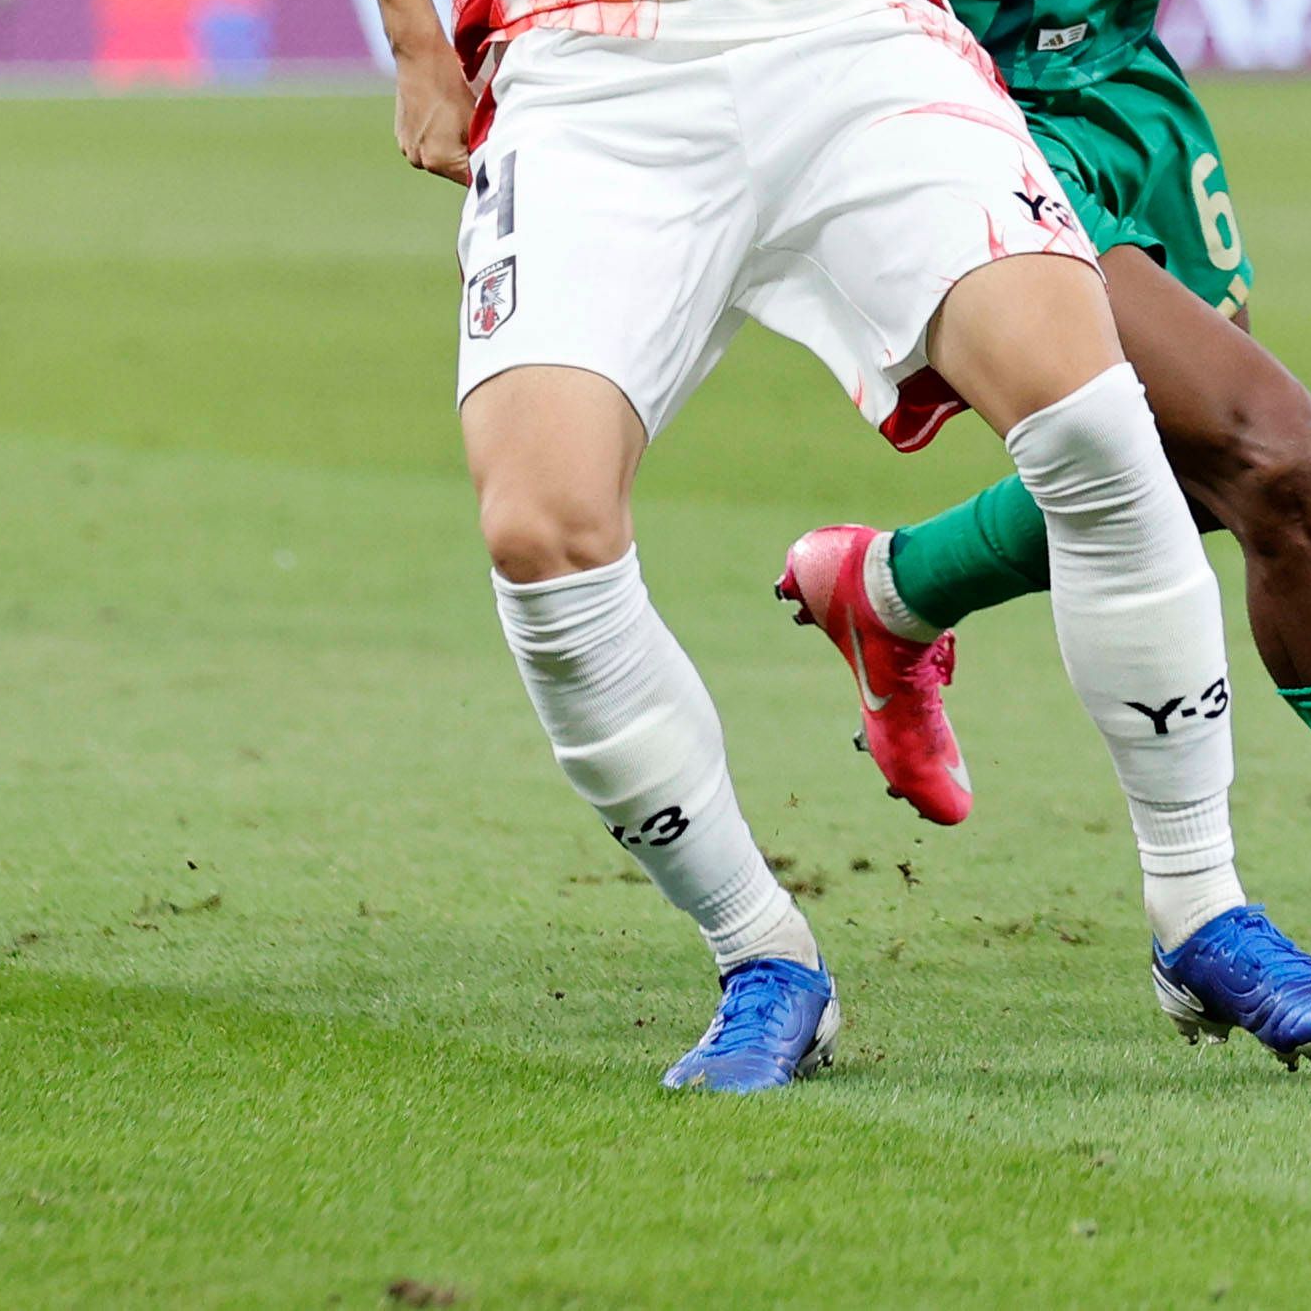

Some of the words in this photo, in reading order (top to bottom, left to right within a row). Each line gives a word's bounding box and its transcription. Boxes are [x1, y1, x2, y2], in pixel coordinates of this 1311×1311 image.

[474, 149, 517, 241] 4
[1012, 191, 1078, 232] Y-3
[1191, 152, 1242, 271] 6
[1122, 677, 1228, 735] Y-3
